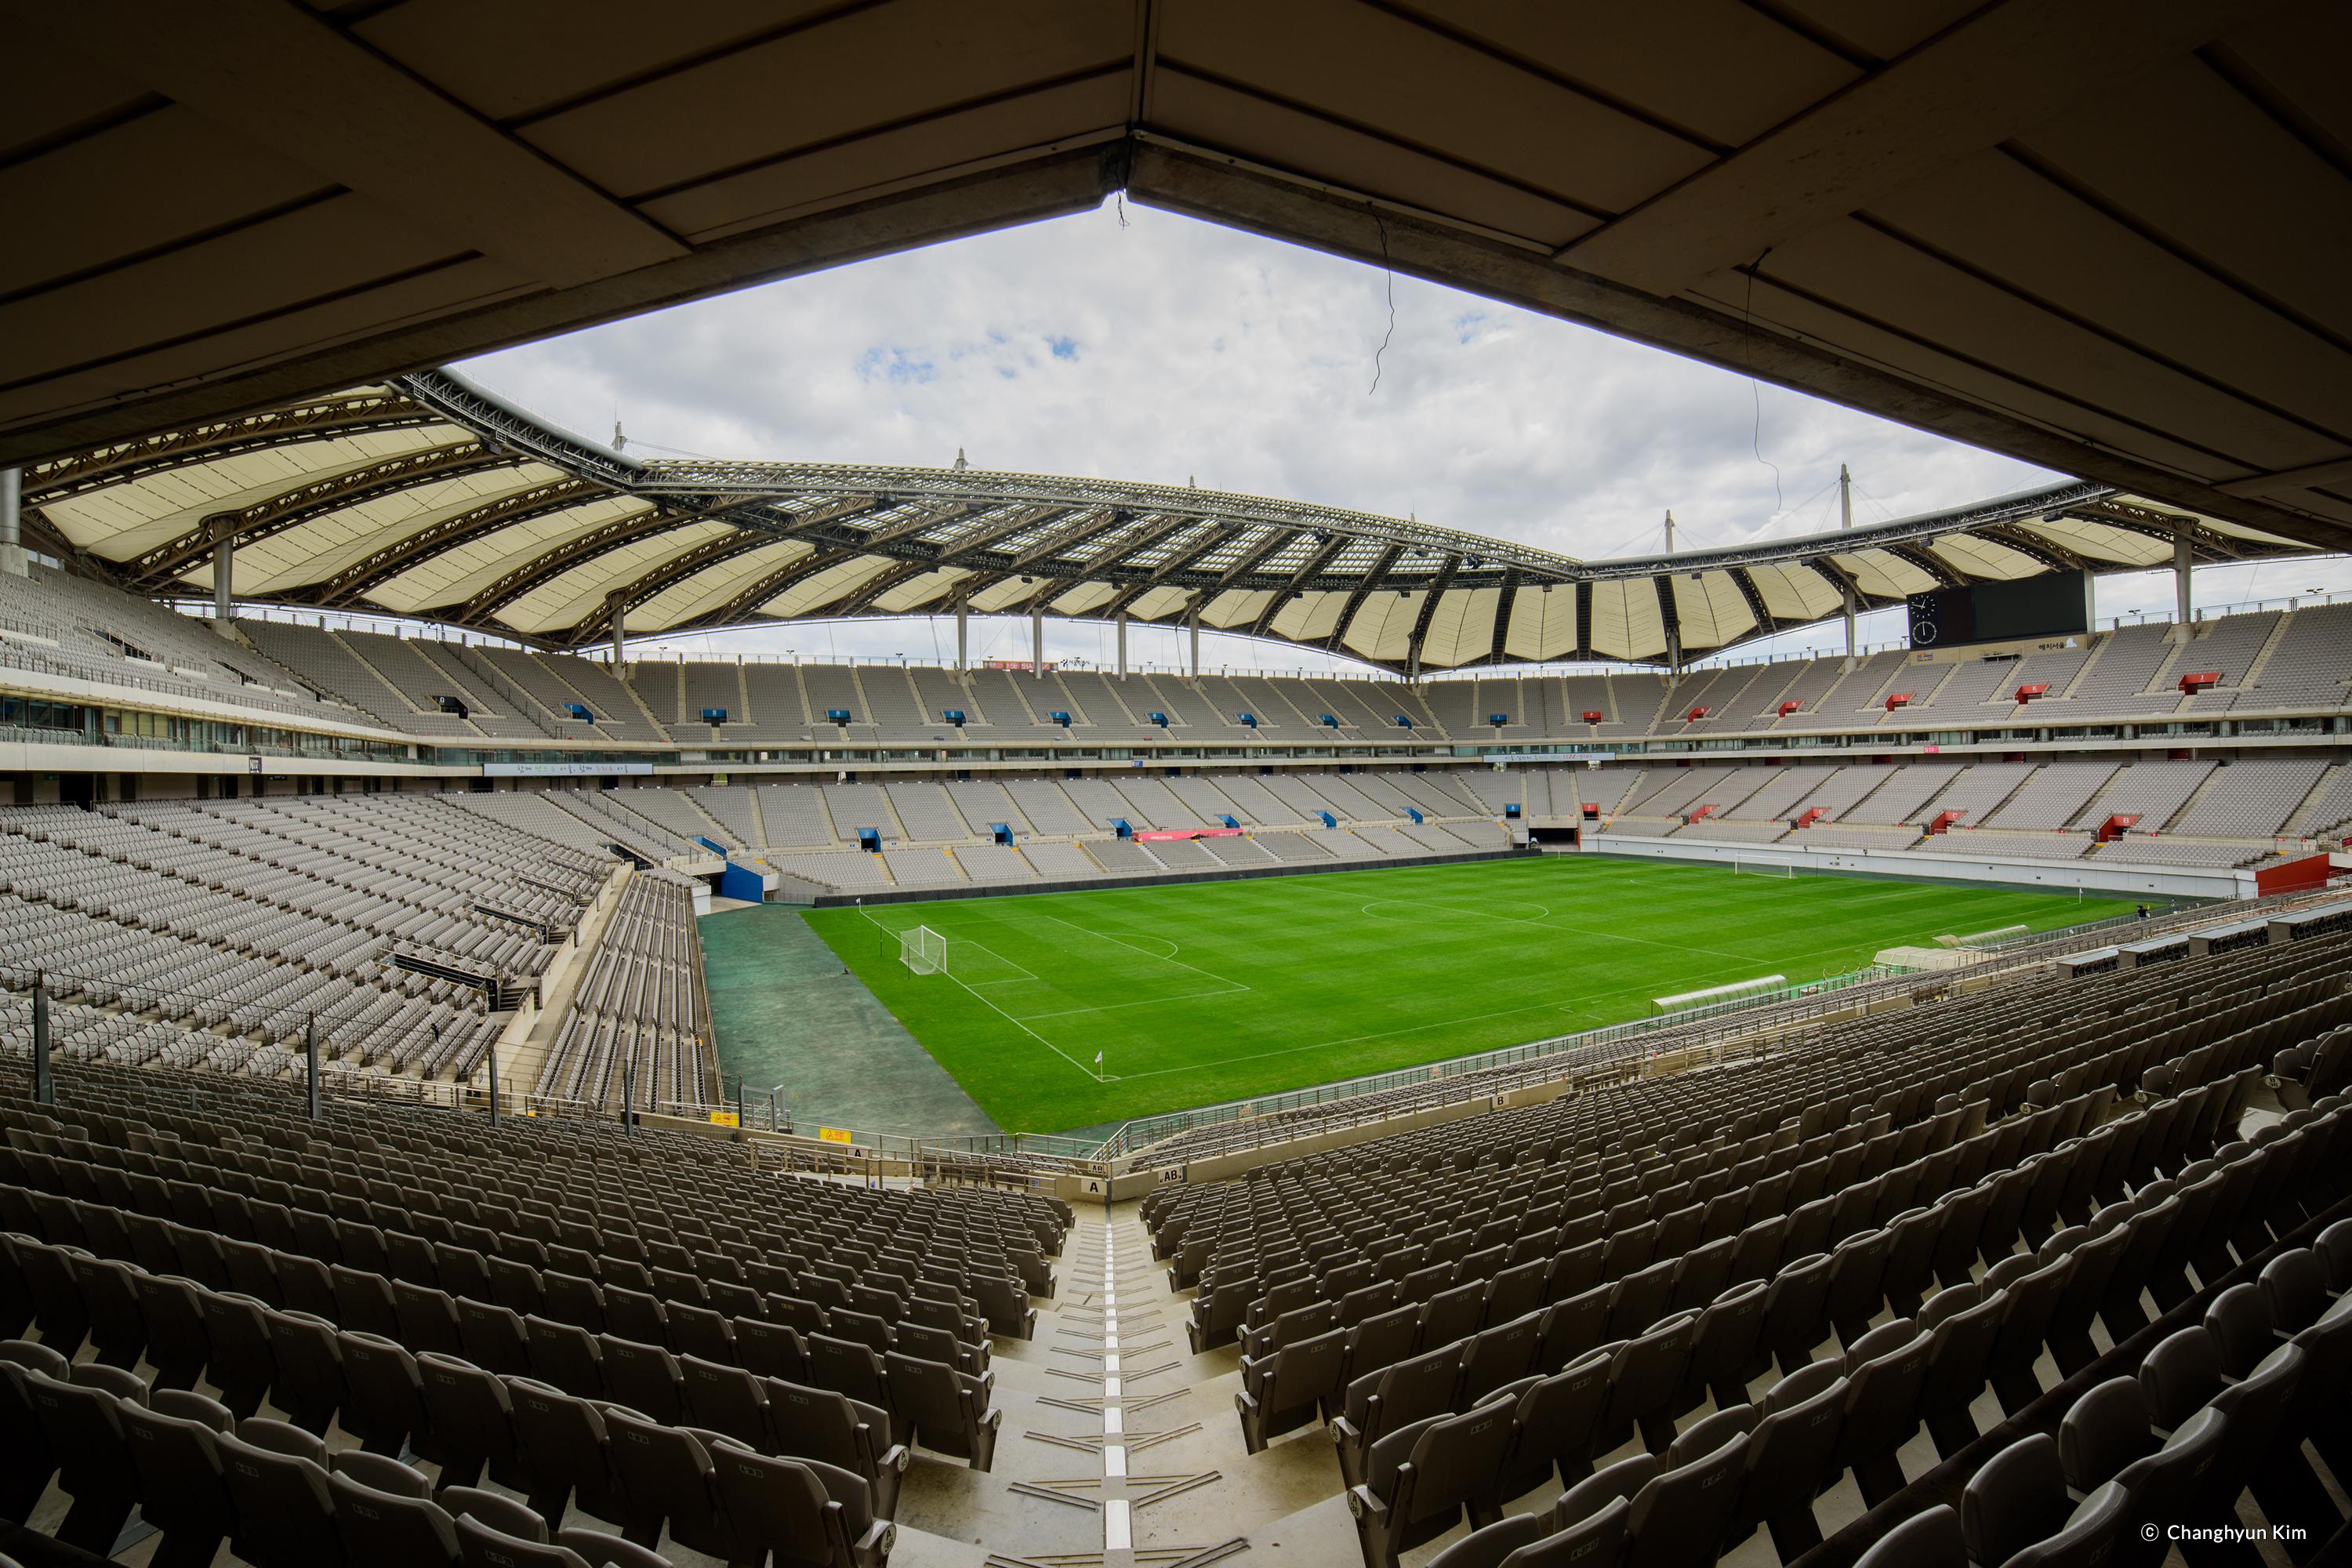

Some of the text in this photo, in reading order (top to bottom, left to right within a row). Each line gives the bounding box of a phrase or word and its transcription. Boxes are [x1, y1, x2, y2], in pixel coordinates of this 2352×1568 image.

[1497, 1096, 1504, 1105] B
[854, 1149, 862, 1157] A
[1163, 1170, 1178, 1181] AB
[1089, 1181, 1098, 1192] A
[1352, 1494, 1358, 1506] A
[887, 1530, 891, 1541] A
